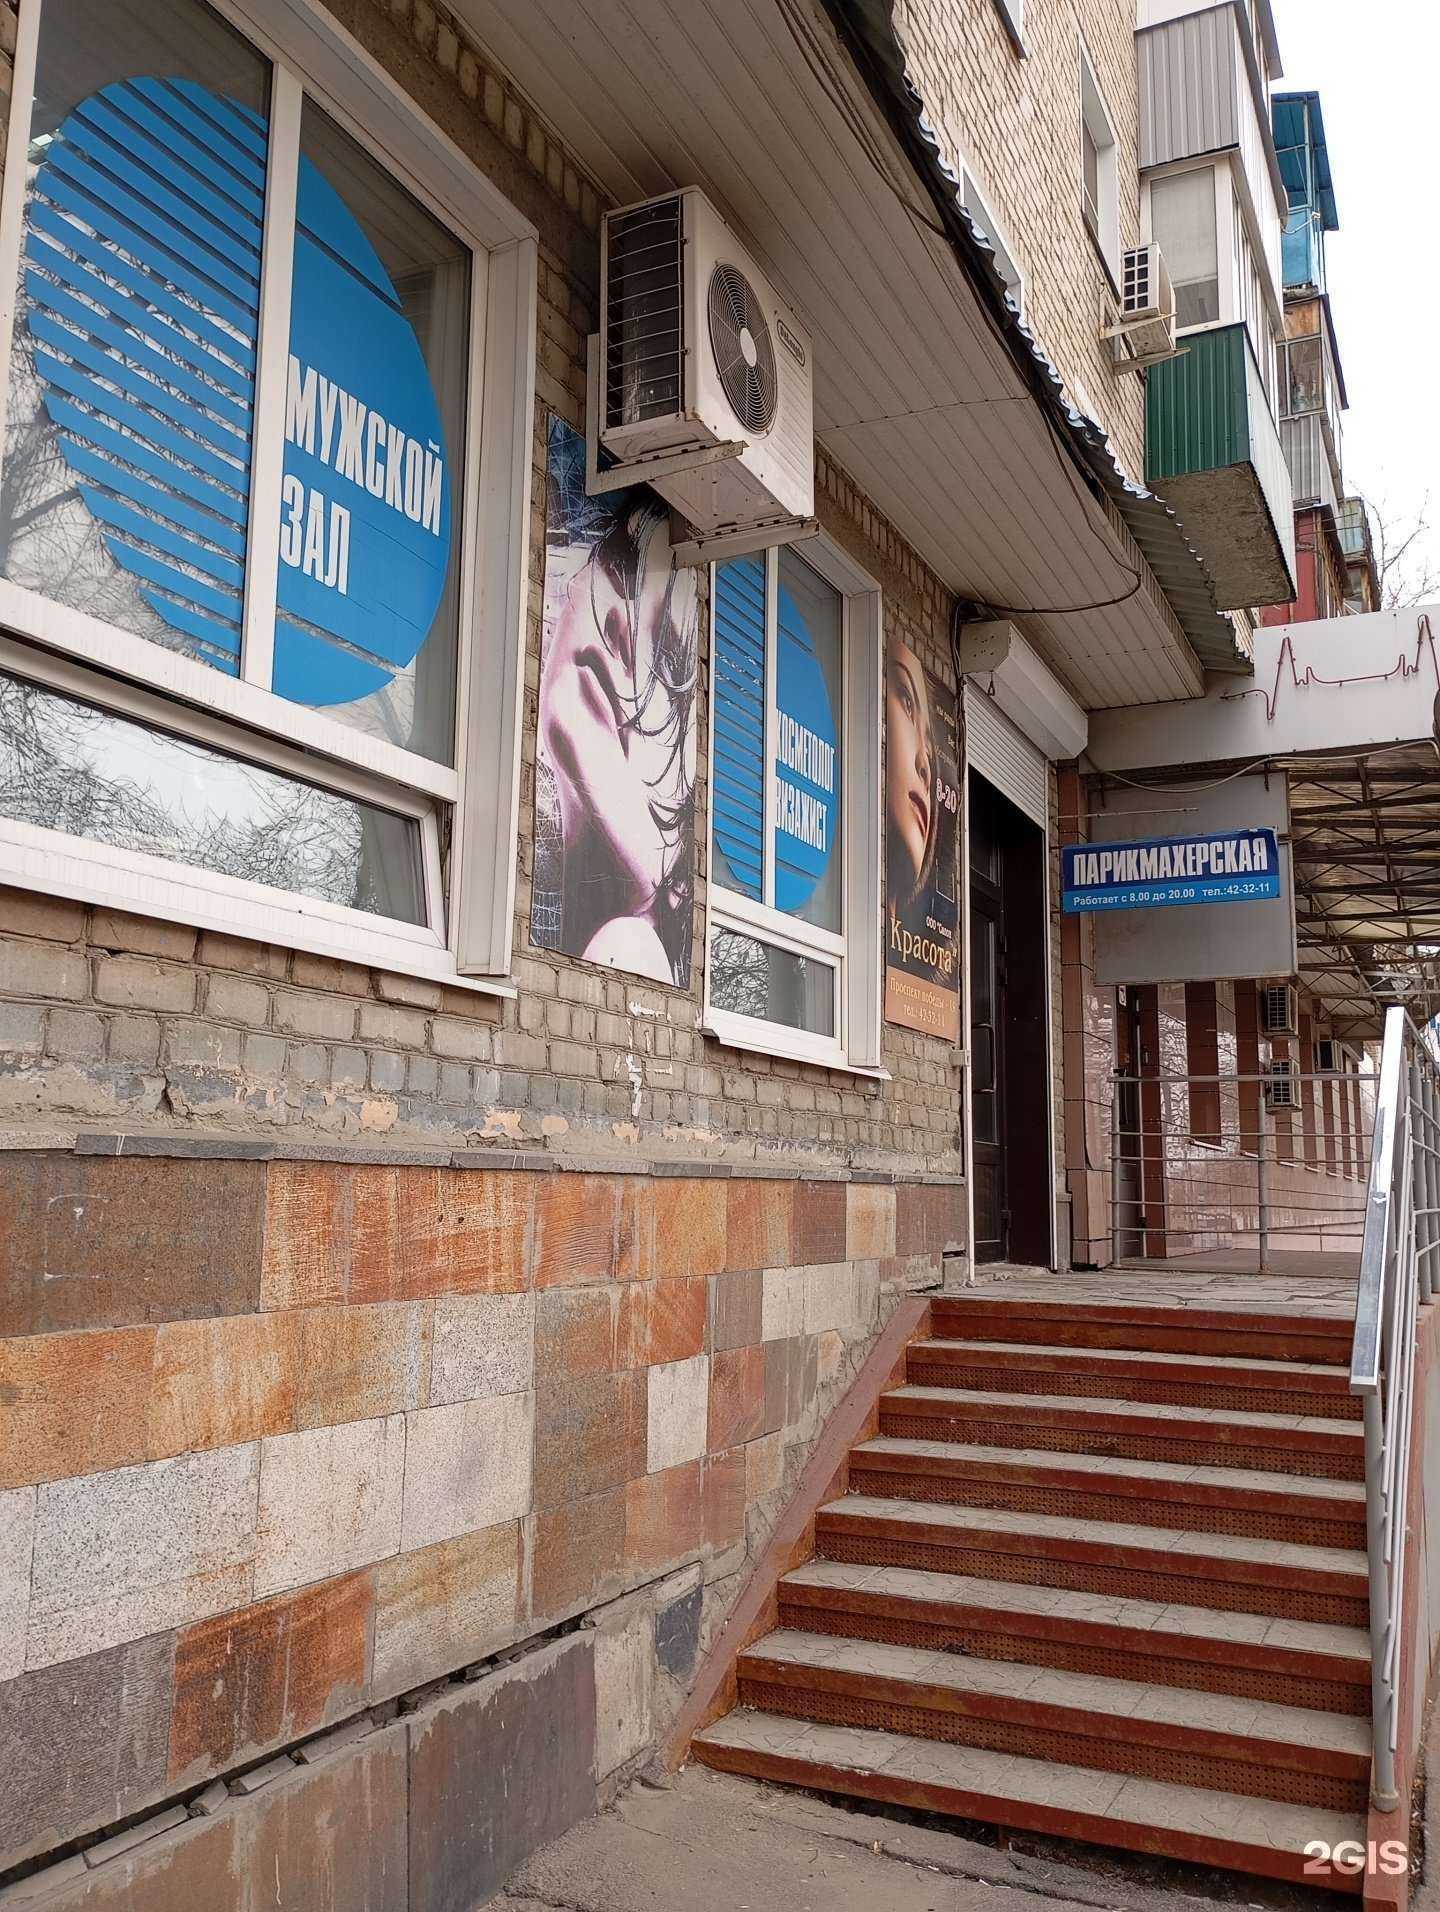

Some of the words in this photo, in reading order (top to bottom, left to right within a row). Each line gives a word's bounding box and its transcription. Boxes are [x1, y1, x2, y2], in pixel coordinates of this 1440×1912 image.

[285, 354, 443, 536] МУЖСКОЙ
[280, 474, 350, 596] ЗАЛ
[775, 776, 827, 853] ВИЗАЖИСТ
[1073, 837, 1268, 886] ПАРИКМАХЕРСКАЯ
[1073, 895, 1119, 906] Работает
[1129, 892, 1150, 902] 8.00
[1152, 892, 1166, 901] до
[1168, 888, 1195, 899] 20.00
[890, 917, 957, 973] Красота"
